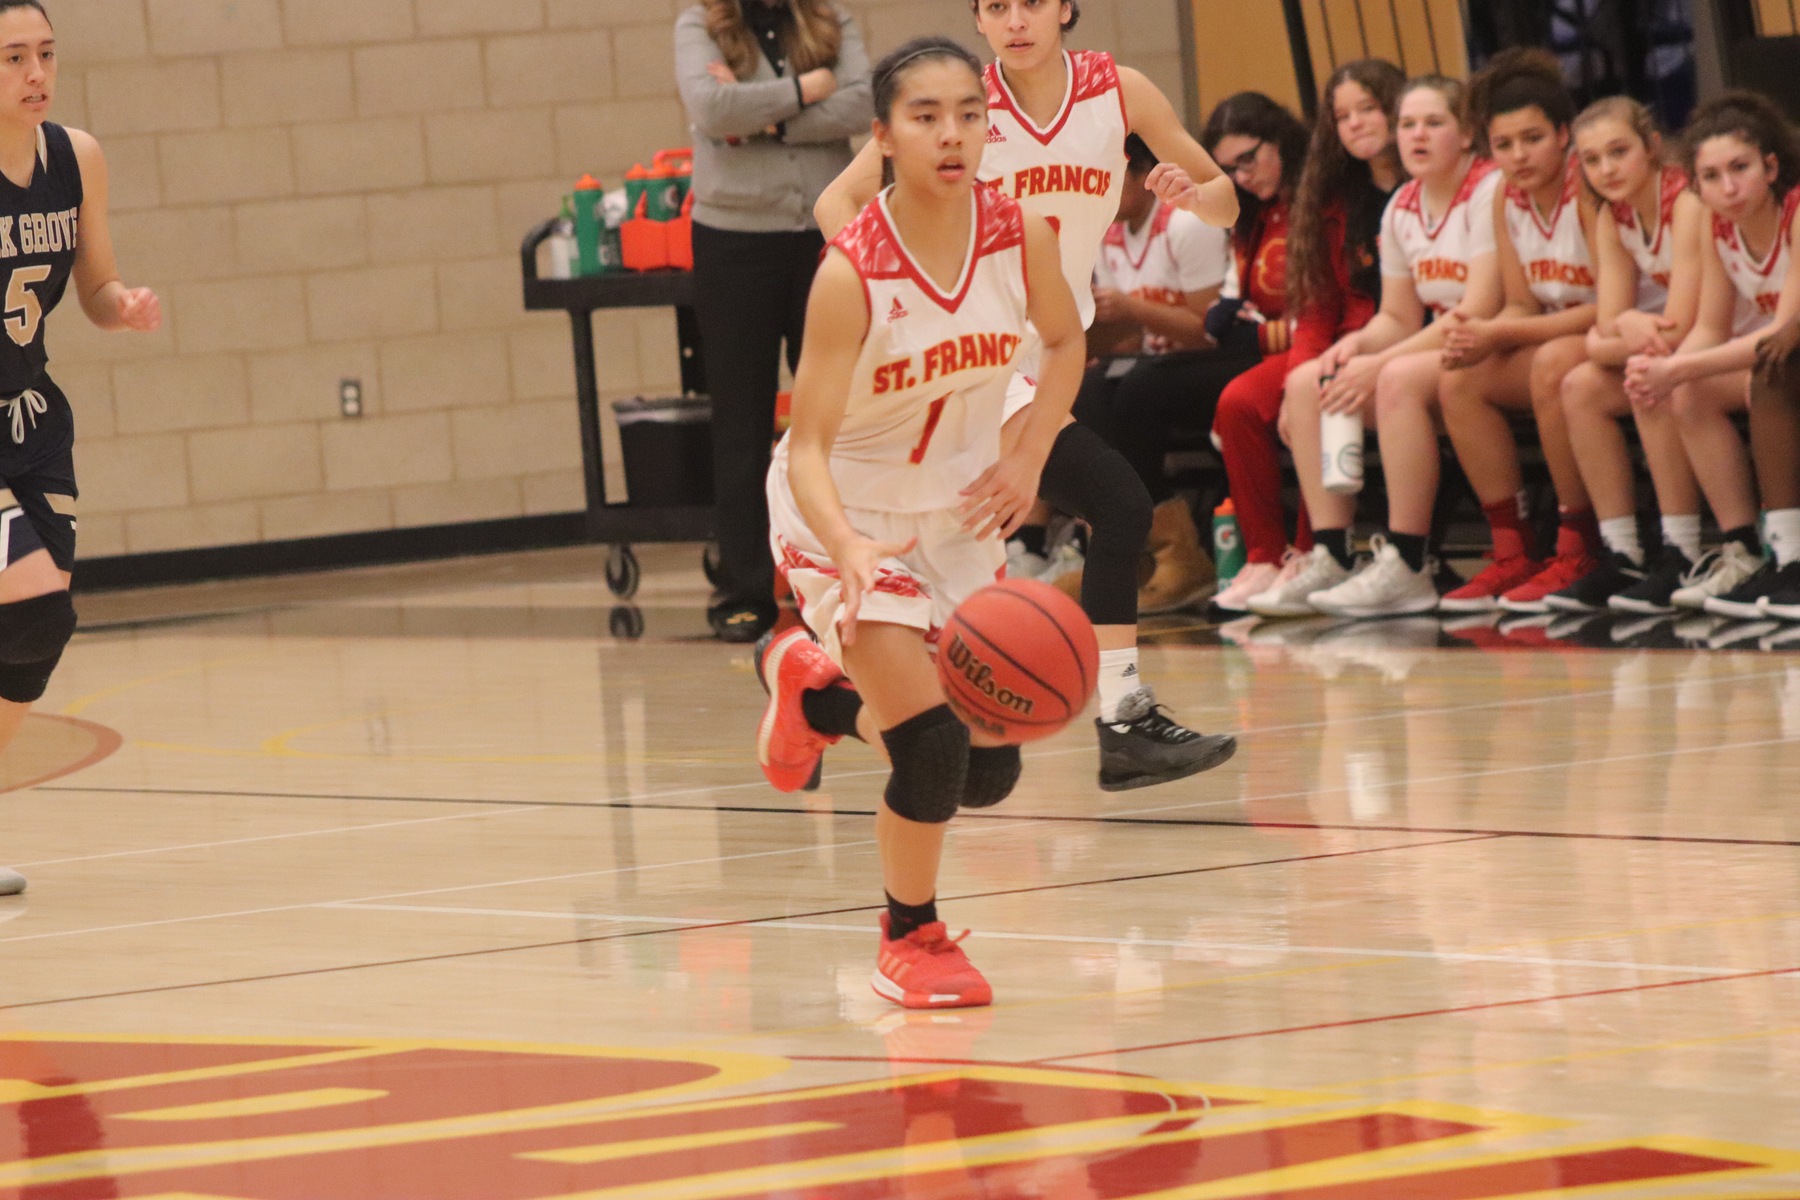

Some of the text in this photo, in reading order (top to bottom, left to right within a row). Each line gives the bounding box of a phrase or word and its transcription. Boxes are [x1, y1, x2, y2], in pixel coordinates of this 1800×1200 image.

[1013, 163, 1111, 200] FRANCIS
[0, 214, 18, 259] K
[4, 264, 52, 346] 5
[872, 356, 917, 396] ST.
[946, 632, 1035, 715] Wilson
